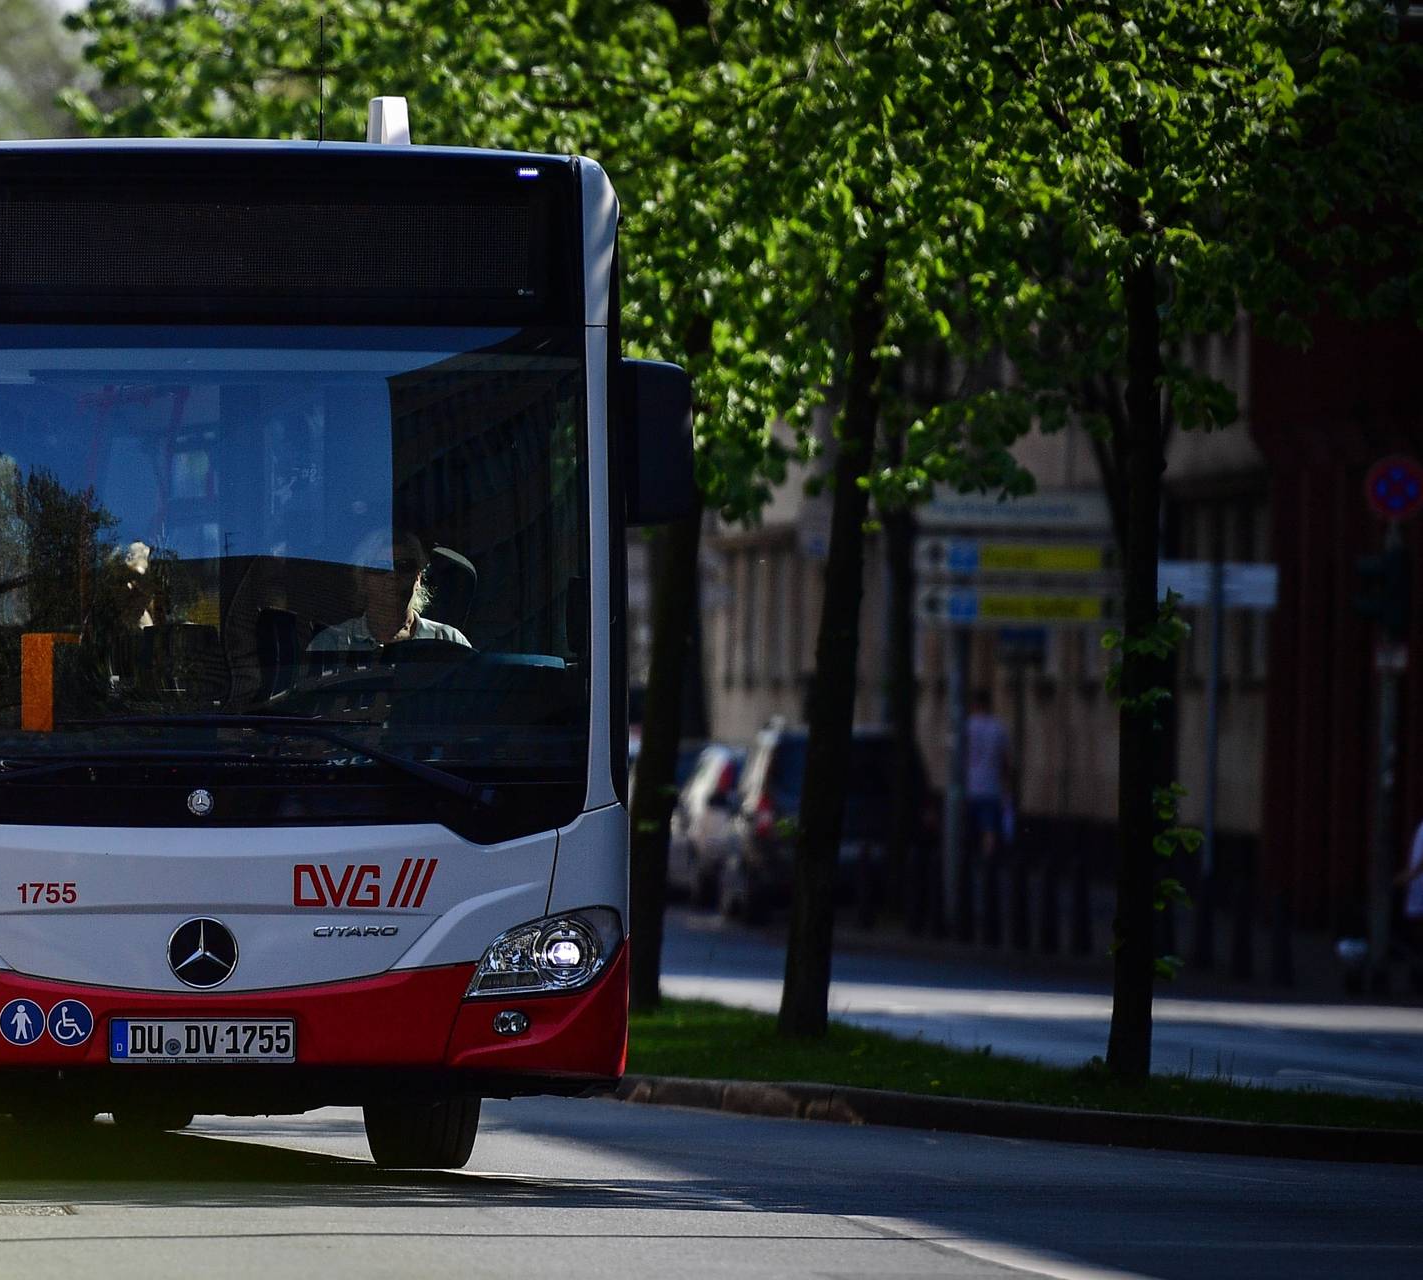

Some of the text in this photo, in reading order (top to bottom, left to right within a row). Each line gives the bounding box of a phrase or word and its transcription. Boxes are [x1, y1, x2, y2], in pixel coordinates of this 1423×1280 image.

[17, 883, 77, 904] 1755
[293, 864, 381, 907] DVG
[313, 924, 399, 938] CITARO
[116, 1042, 123, 1052] D
[130, 1025, 164, 1054] DU
